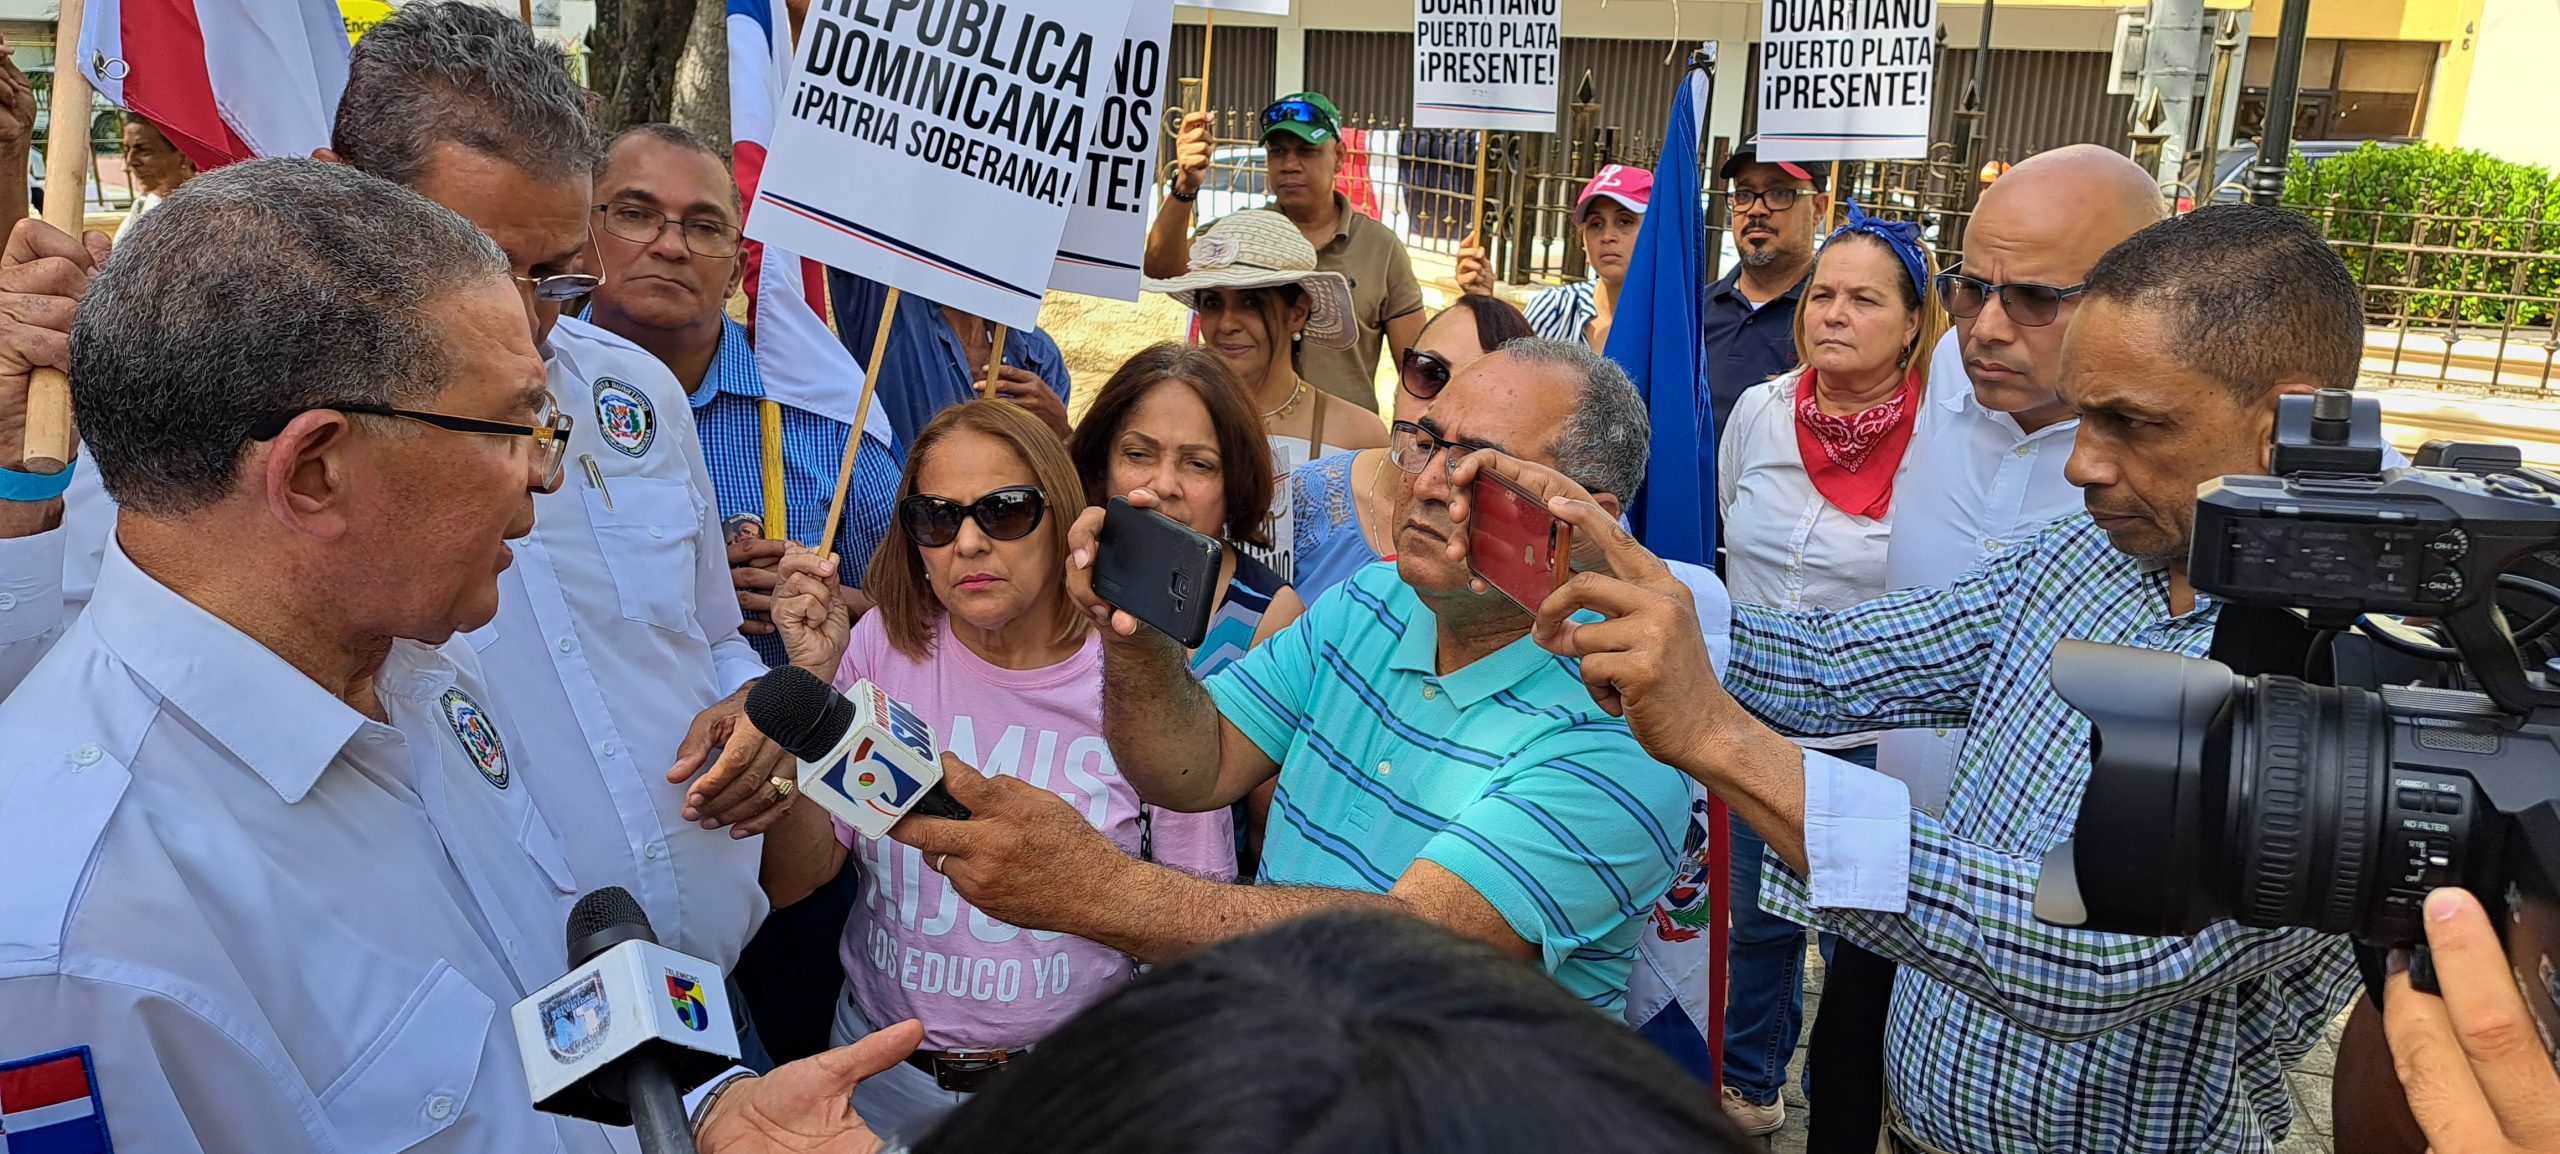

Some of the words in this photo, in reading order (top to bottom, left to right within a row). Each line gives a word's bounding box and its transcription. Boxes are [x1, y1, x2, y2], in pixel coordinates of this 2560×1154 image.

[821, 0, 1093, 99] PUBLICA
[1418, 21, 1492, 47] PUERTO
[1499, 22, 1558, 49] PLATA
[1764, 39, 1854, 70] PUERTO
[1861, 37, 1932, 67] PLATA
[1770, 0, 1931, 33] DUARTIANO
[805, 18, 1084, 163] DOMINICANA
[1420, 52, 1555, 85] ¡PRESENTE!
[1765, 72, 1927, 110] ¡PRESENTE!
[791, 82, 900, 150] ¡PATRIA
[905, 120, 1073, 207] SOBERANA!
[948, 715, 1116, 829] MIS
[859, 833, 1065, 943] HIJ
[867, 919, 898, 980] LOS
[901, 947, 1022, 1002] EDUCO
[1032, 952, 1070, 999] YO
